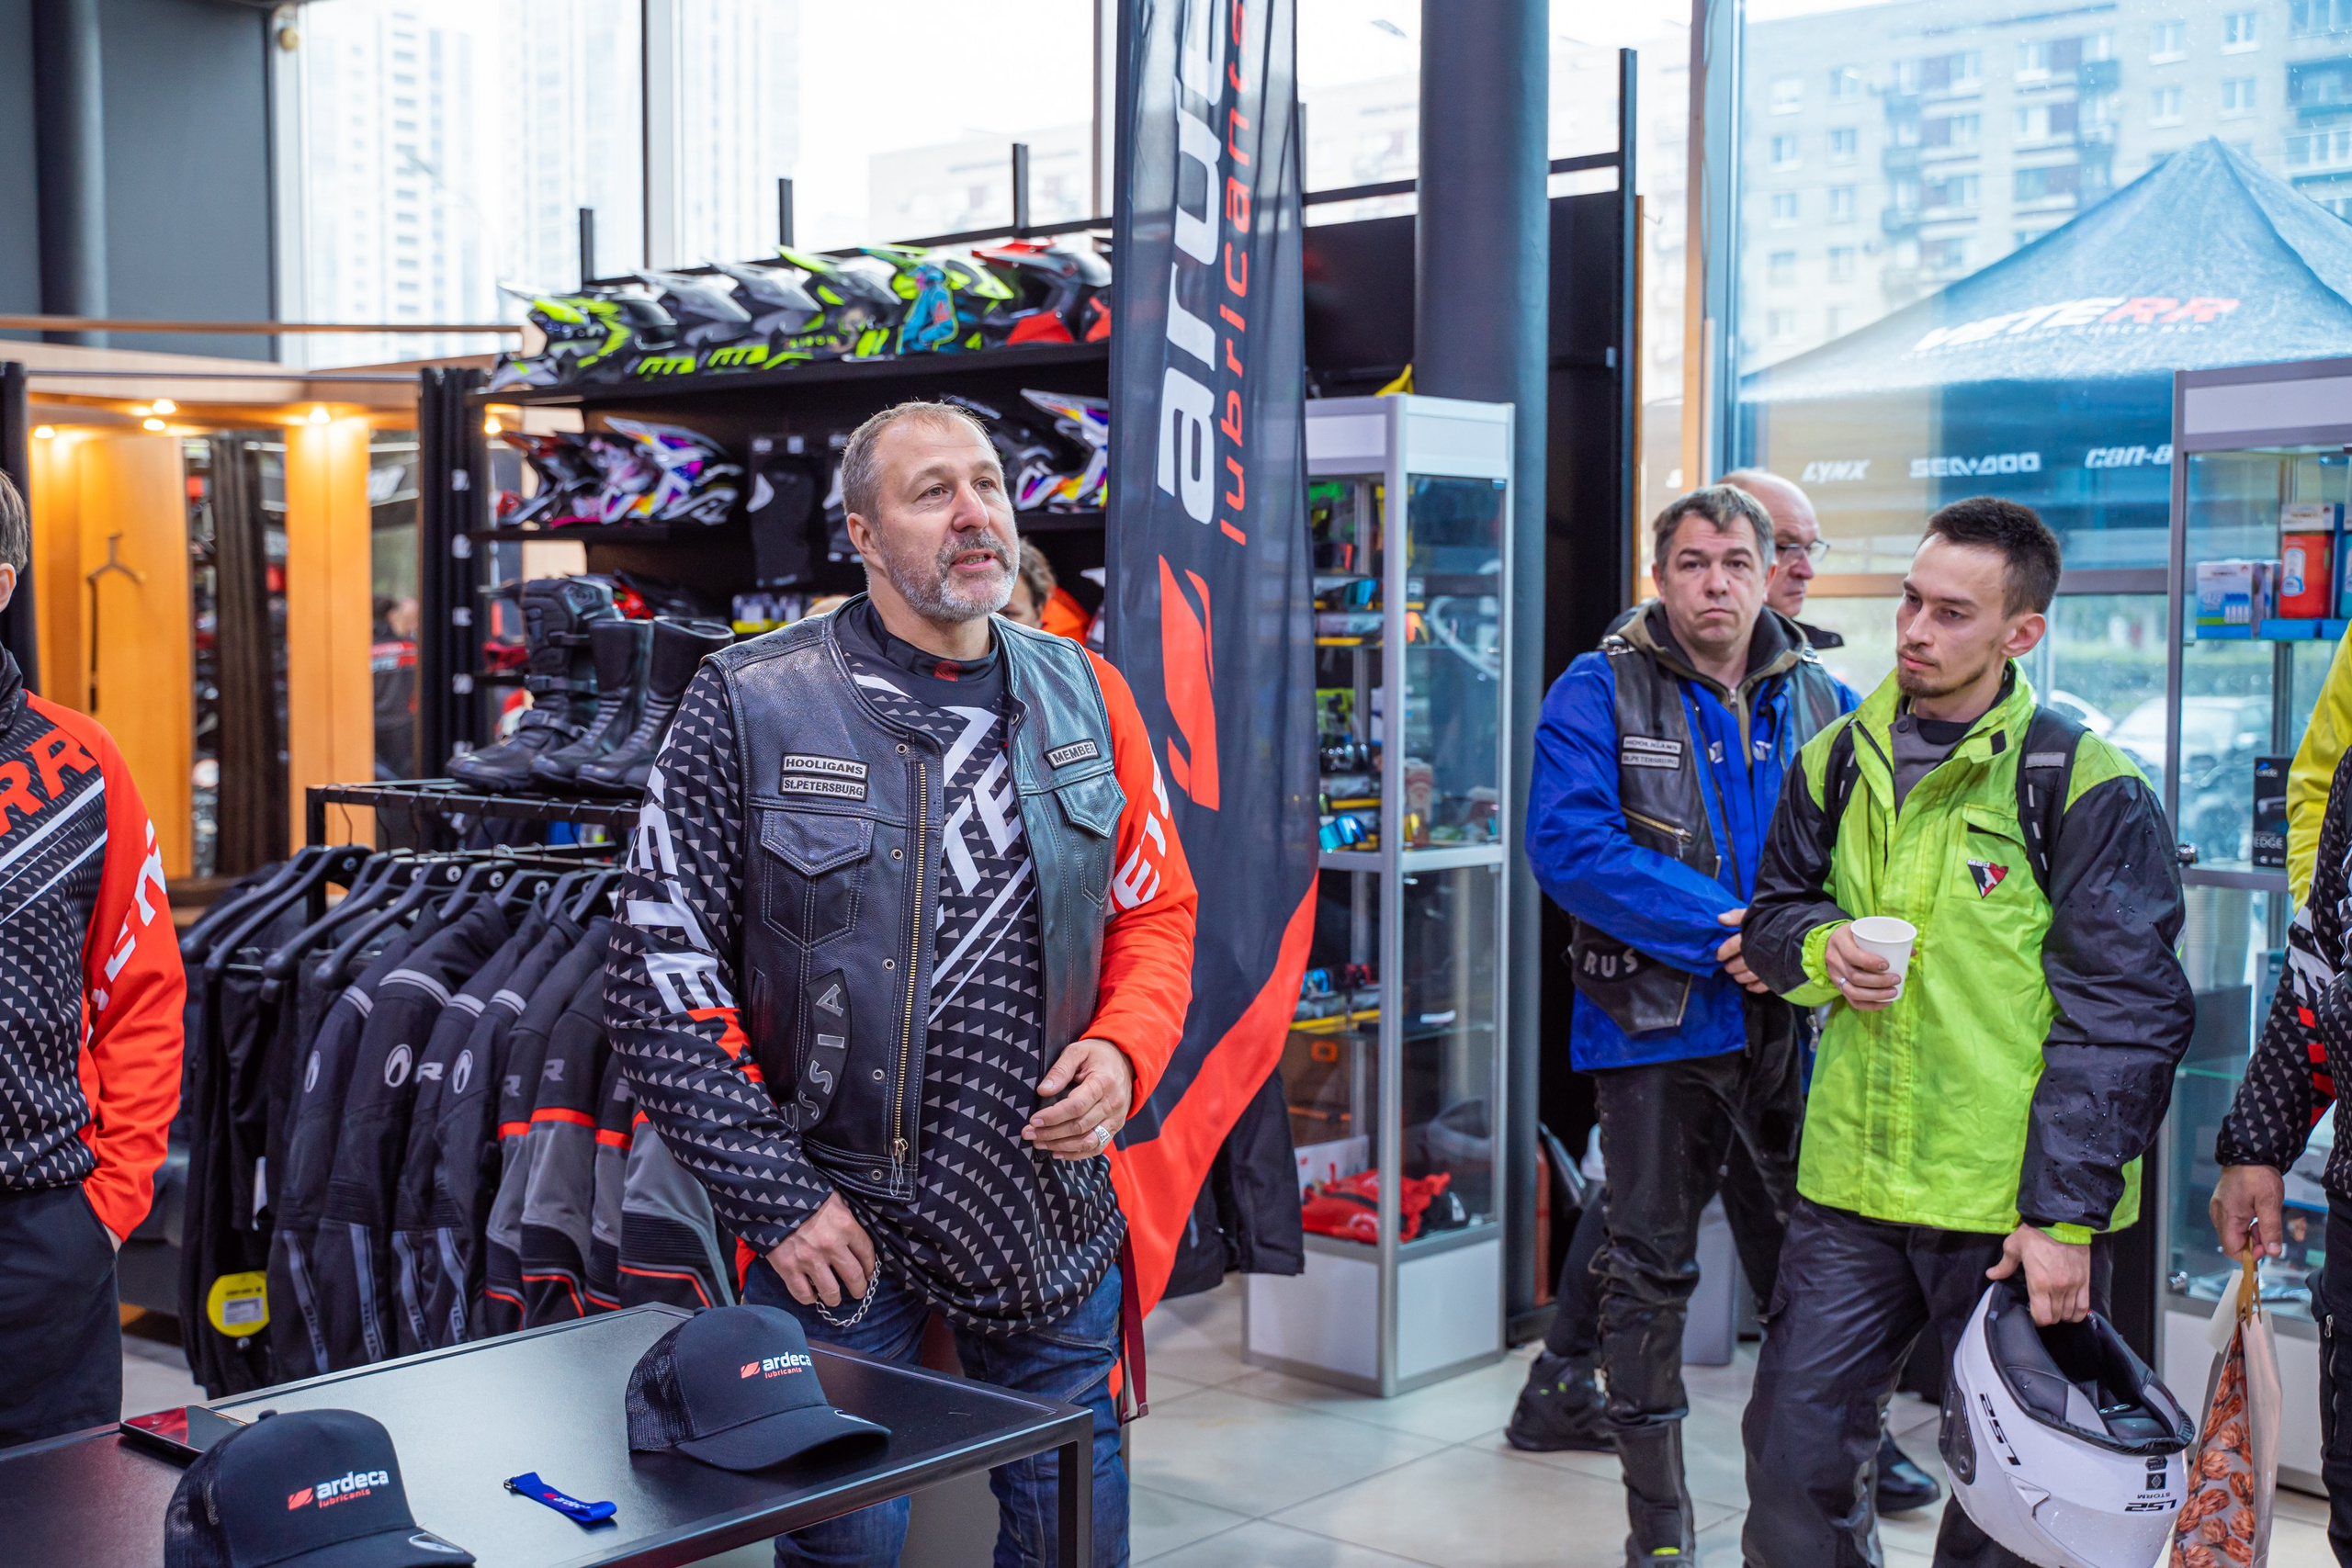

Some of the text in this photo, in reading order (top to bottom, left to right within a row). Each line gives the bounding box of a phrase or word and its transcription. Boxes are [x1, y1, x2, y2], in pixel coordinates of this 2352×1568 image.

[1802, 458, 1871, 484] LYNX
[1052, 742, 1097, 764] MEMBER
[786, 758, 864, 775] HOOLIGANS
[784, 779, 864, 796] St.PETERSBURG
[762, 1350, 812, 1371] ardeca
[764, 1366, 803, 1379] lubricants
[315, 1470, 390, 1499] ardeca
[318, 1488, 371, 1509] lubricants
[2123, 1498, 2177, 1513] LS2
[2137, 1492, 2171, 1500] STORM
